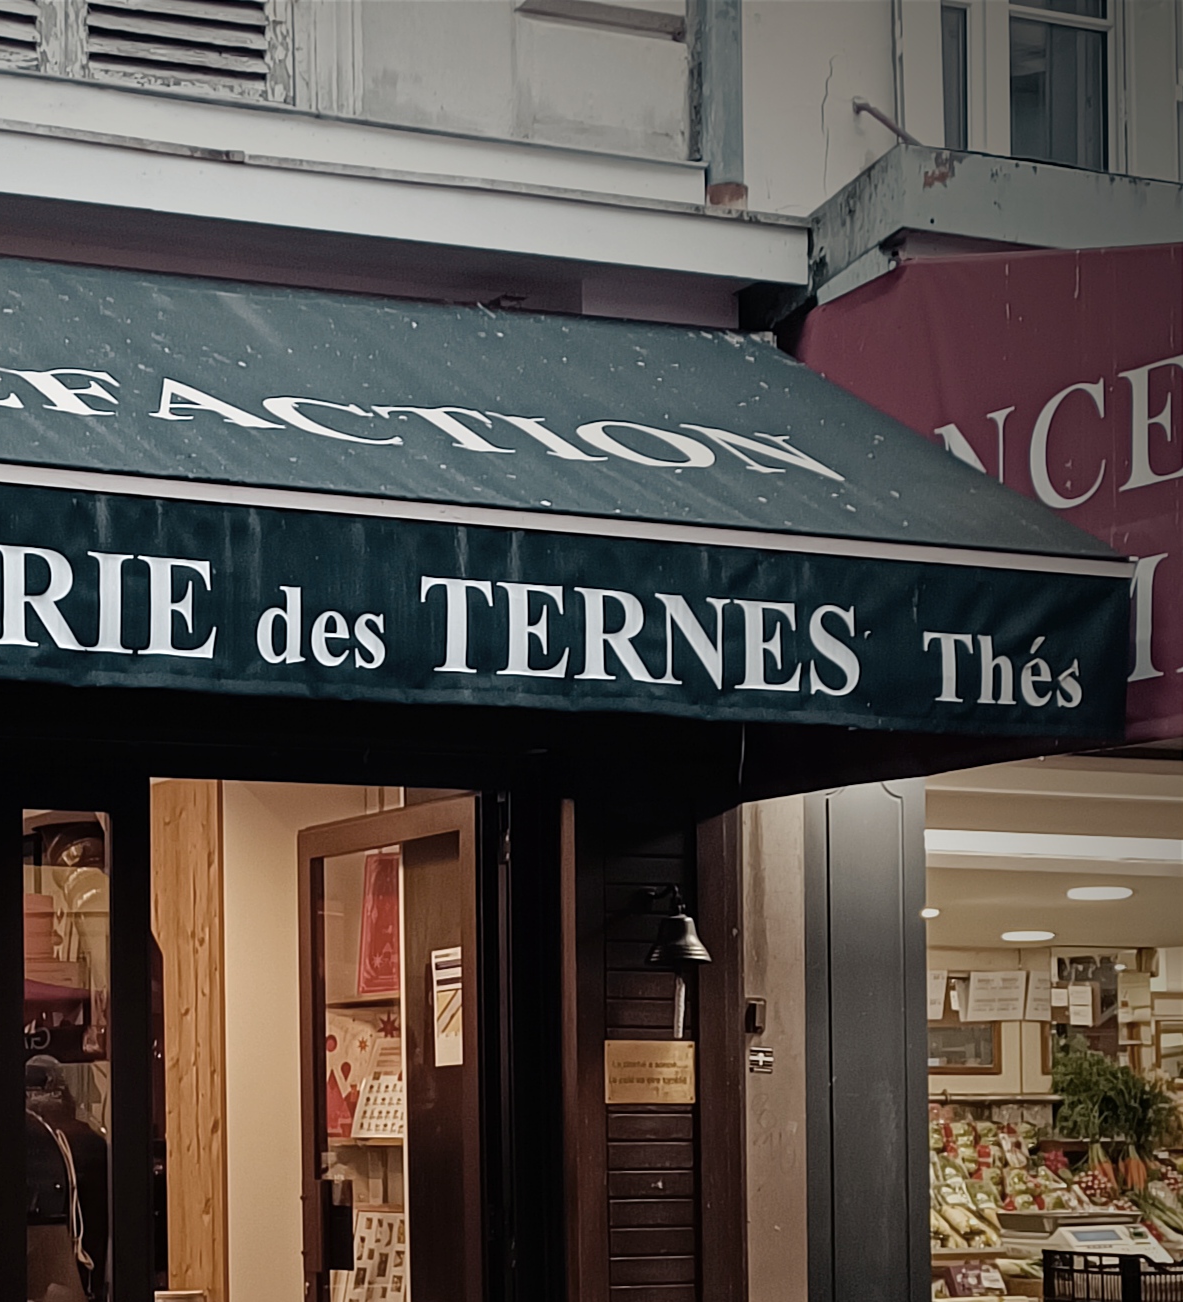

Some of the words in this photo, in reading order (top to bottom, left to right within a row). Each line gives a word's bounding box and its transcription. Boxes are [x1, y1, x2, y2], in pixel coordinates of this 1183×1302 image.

[256, 586, 387, 670] des
[419, 575, 861, 697] TERNES
[923, 632, 1084, 708] Thés
